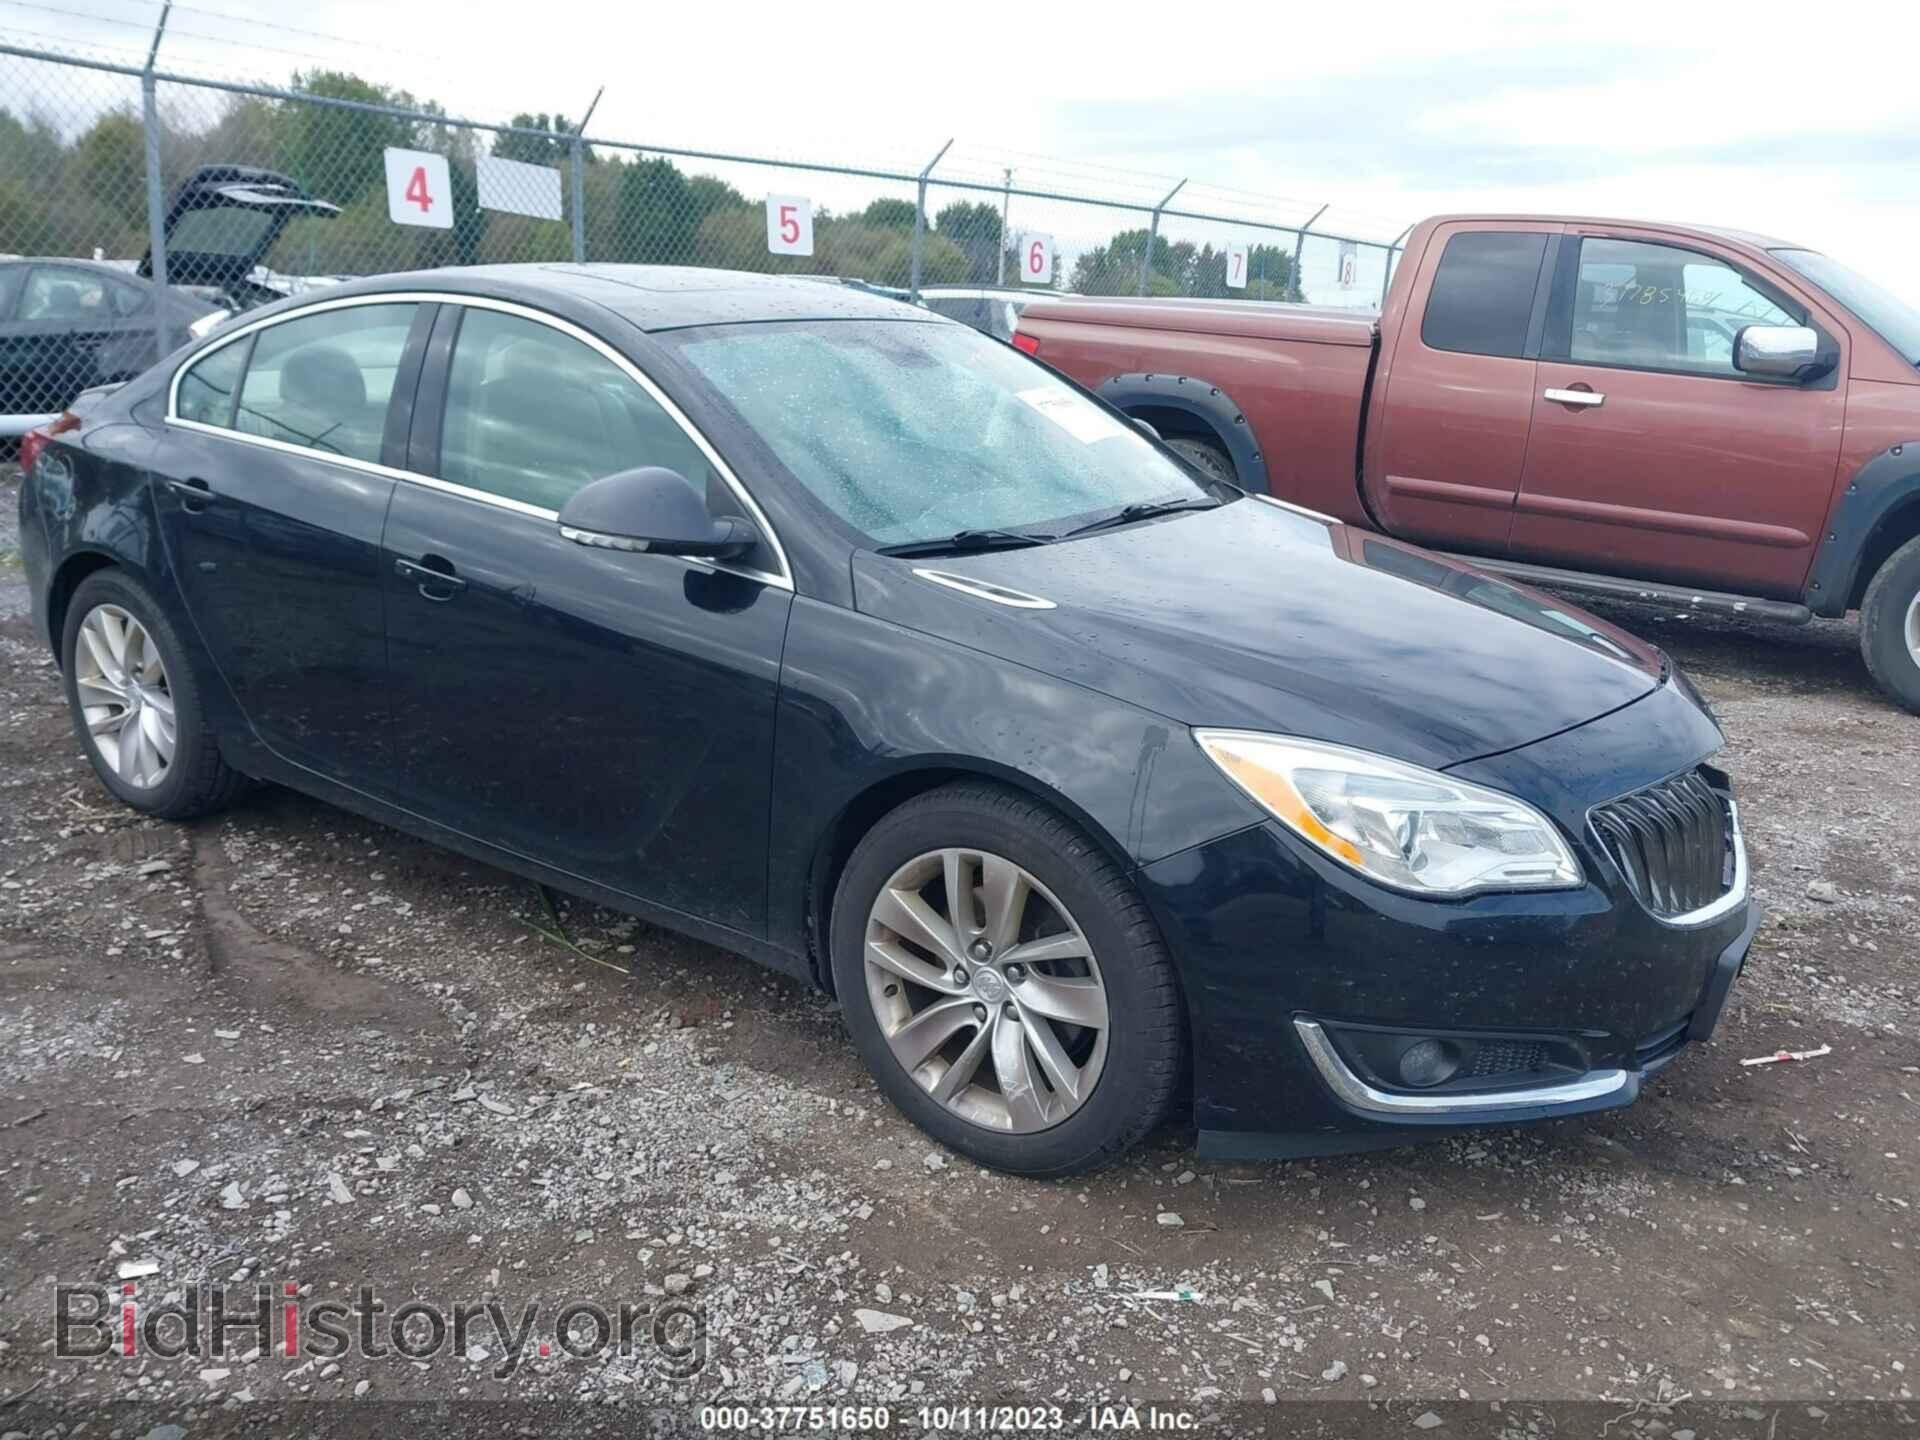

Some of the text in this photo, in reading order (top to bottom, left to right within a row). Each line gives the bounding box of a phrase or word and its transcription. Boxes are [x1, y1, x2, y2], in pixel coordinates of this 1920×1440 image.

[405, 166, 433, 213] 4
[780, 205, 800, 244] 5
[1030, 240, 1044, 274] 6
[1233, 252, 1242, 281] 7
[1344, 261, 1352, 285] 8
